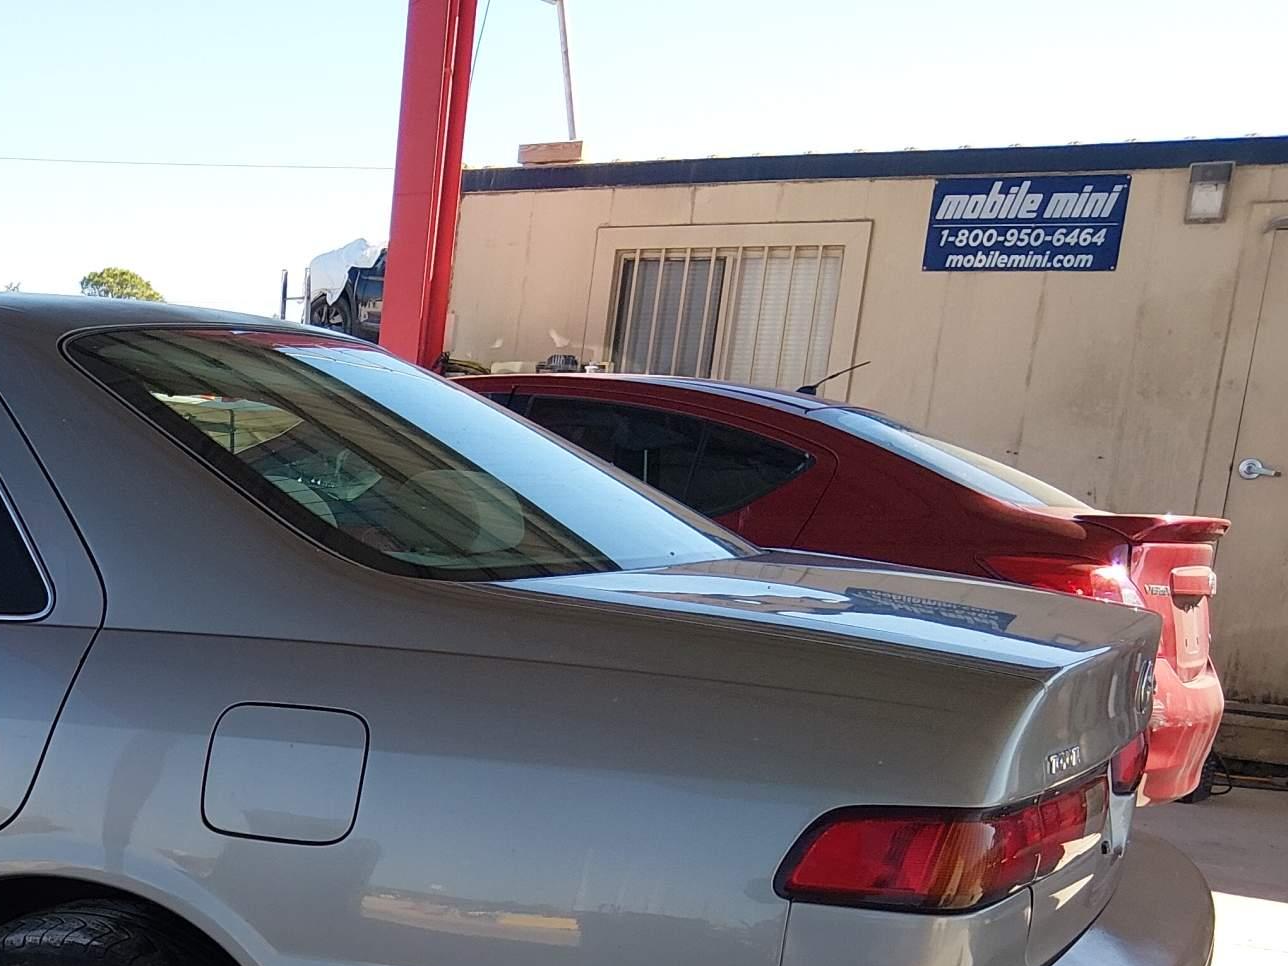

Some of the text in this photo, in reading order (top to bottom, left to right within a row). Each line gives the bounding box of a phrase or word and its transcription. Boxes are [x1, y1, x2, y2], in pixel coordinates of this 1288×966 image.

[935, 180, 1123, 220] mobile mini
[939, 227, 1107, 247] 1-800-950-6464
[945, 250, 1094, 268] mobilemini.com
